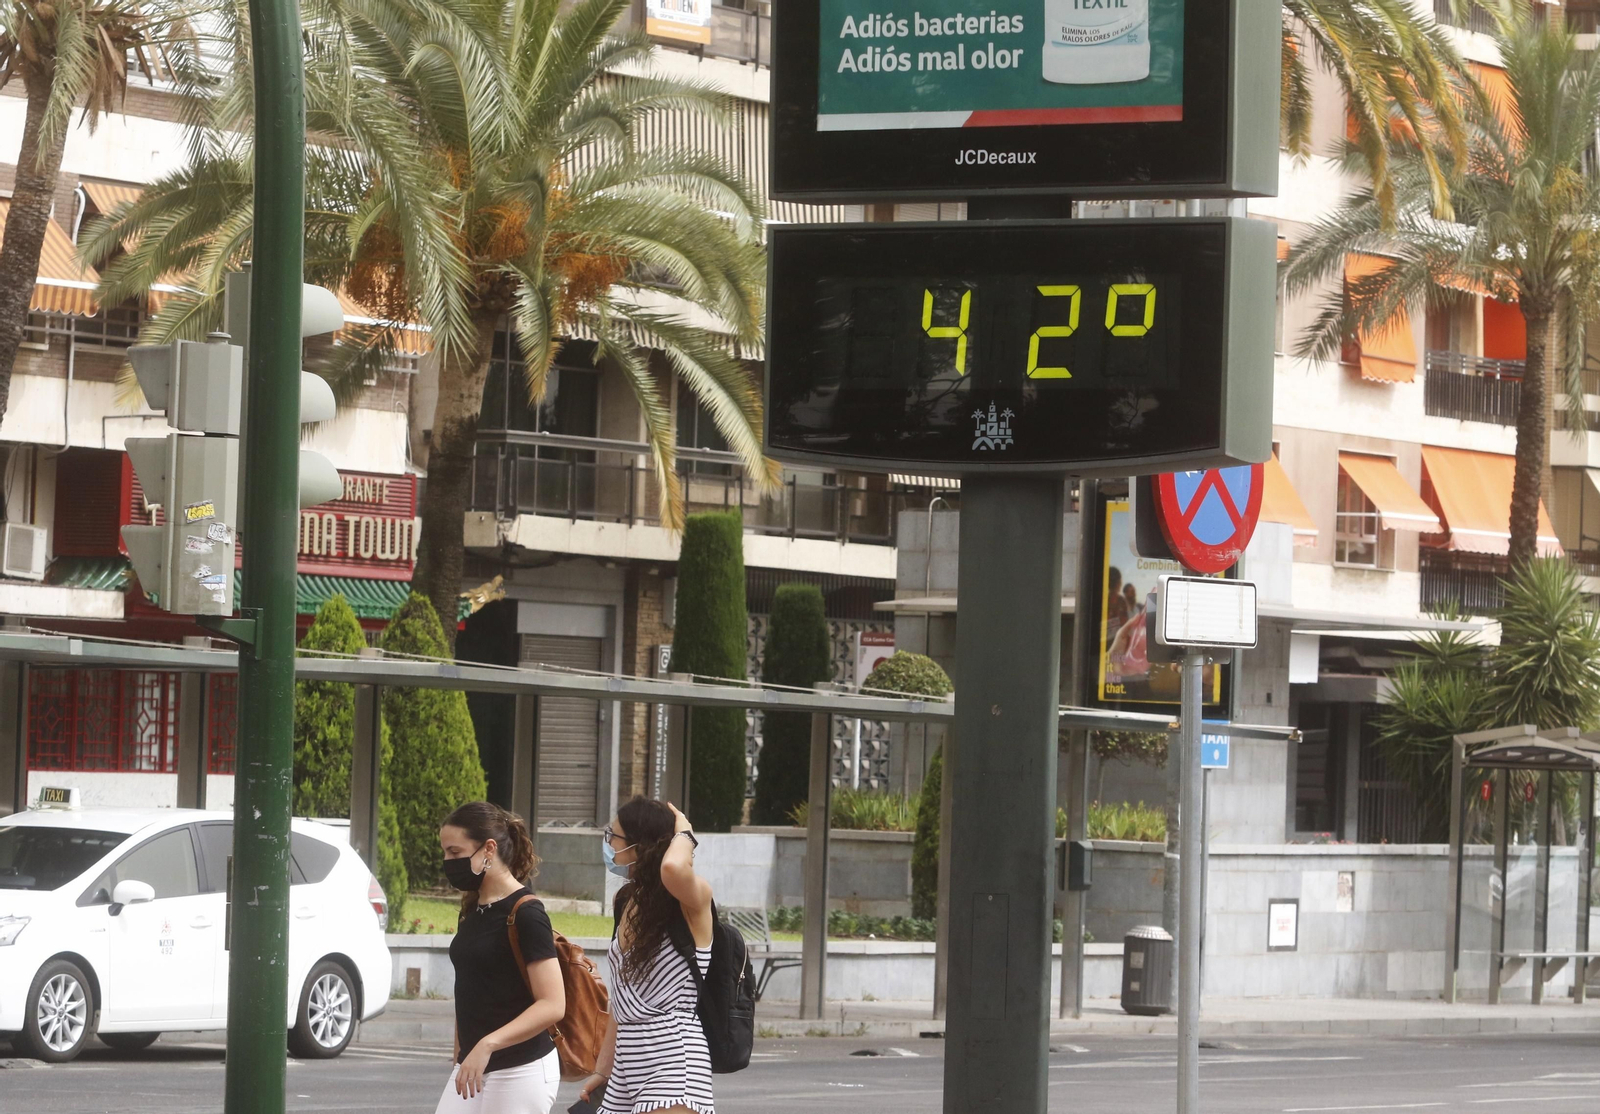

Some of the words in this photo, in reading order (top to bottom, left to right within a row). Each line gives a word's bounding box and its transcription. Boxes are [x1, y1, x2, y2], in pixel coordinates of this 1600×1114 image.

[839, 12, 909, 38] Adiós
[914, 10, 1024, 37] bacterias
[1061, 26, 1087, 35] ELIMINA
[1061, 34, 1083, 43] MALOS
[1084, 33, 1110, 42] OLORES
[837, 45, 911, 73] Adiós
[918, 43, 966, 71] mal
[971, 42, 1024, 70] olor
[955, 149, 1037, 165] JCDecaux
[1106, 662, 1114, 673] it
[1106, 673, 1122, 683] like
[1106, 683, 1127, 694] that.
[46, 789, 64, 802] TAXI
[160, 947, 173, 955] 492
